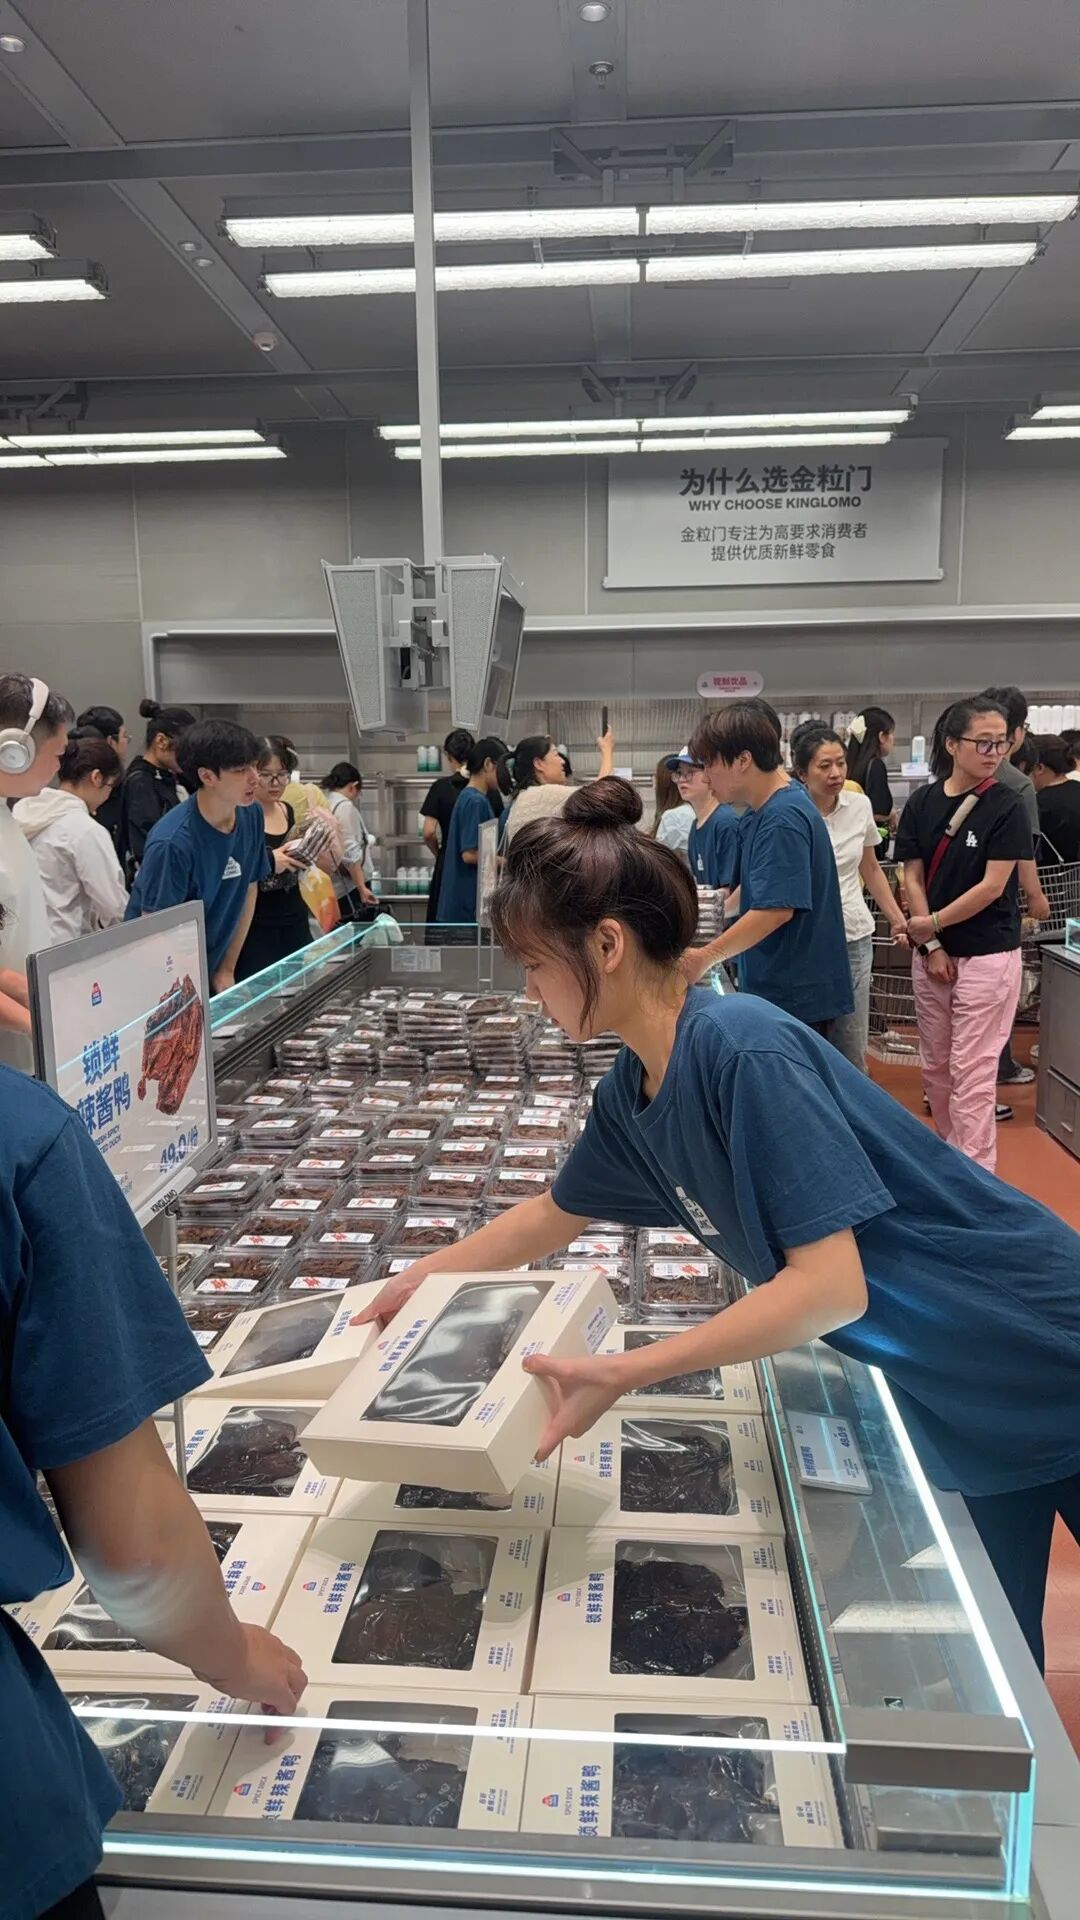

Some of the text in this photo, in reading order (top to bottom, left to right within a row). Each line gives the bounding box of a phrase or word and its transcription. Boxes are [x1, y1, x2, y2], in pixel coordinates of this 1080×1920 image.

[680, 464, 872, 496] 为什么选金粒门
[688, 496, 862, 512] WHY CHOOSE KINGLOMO
[680, 522, 868, 543] 金粒门专注为高要求消费者
[711, 542, 836, 562] 提供优质新鲜零食
[965, 830, 979, 847] LA
[82, 1030, 120, 1086] 锁鲜
[151, 1189, 178, 1214] KINGLOMO
